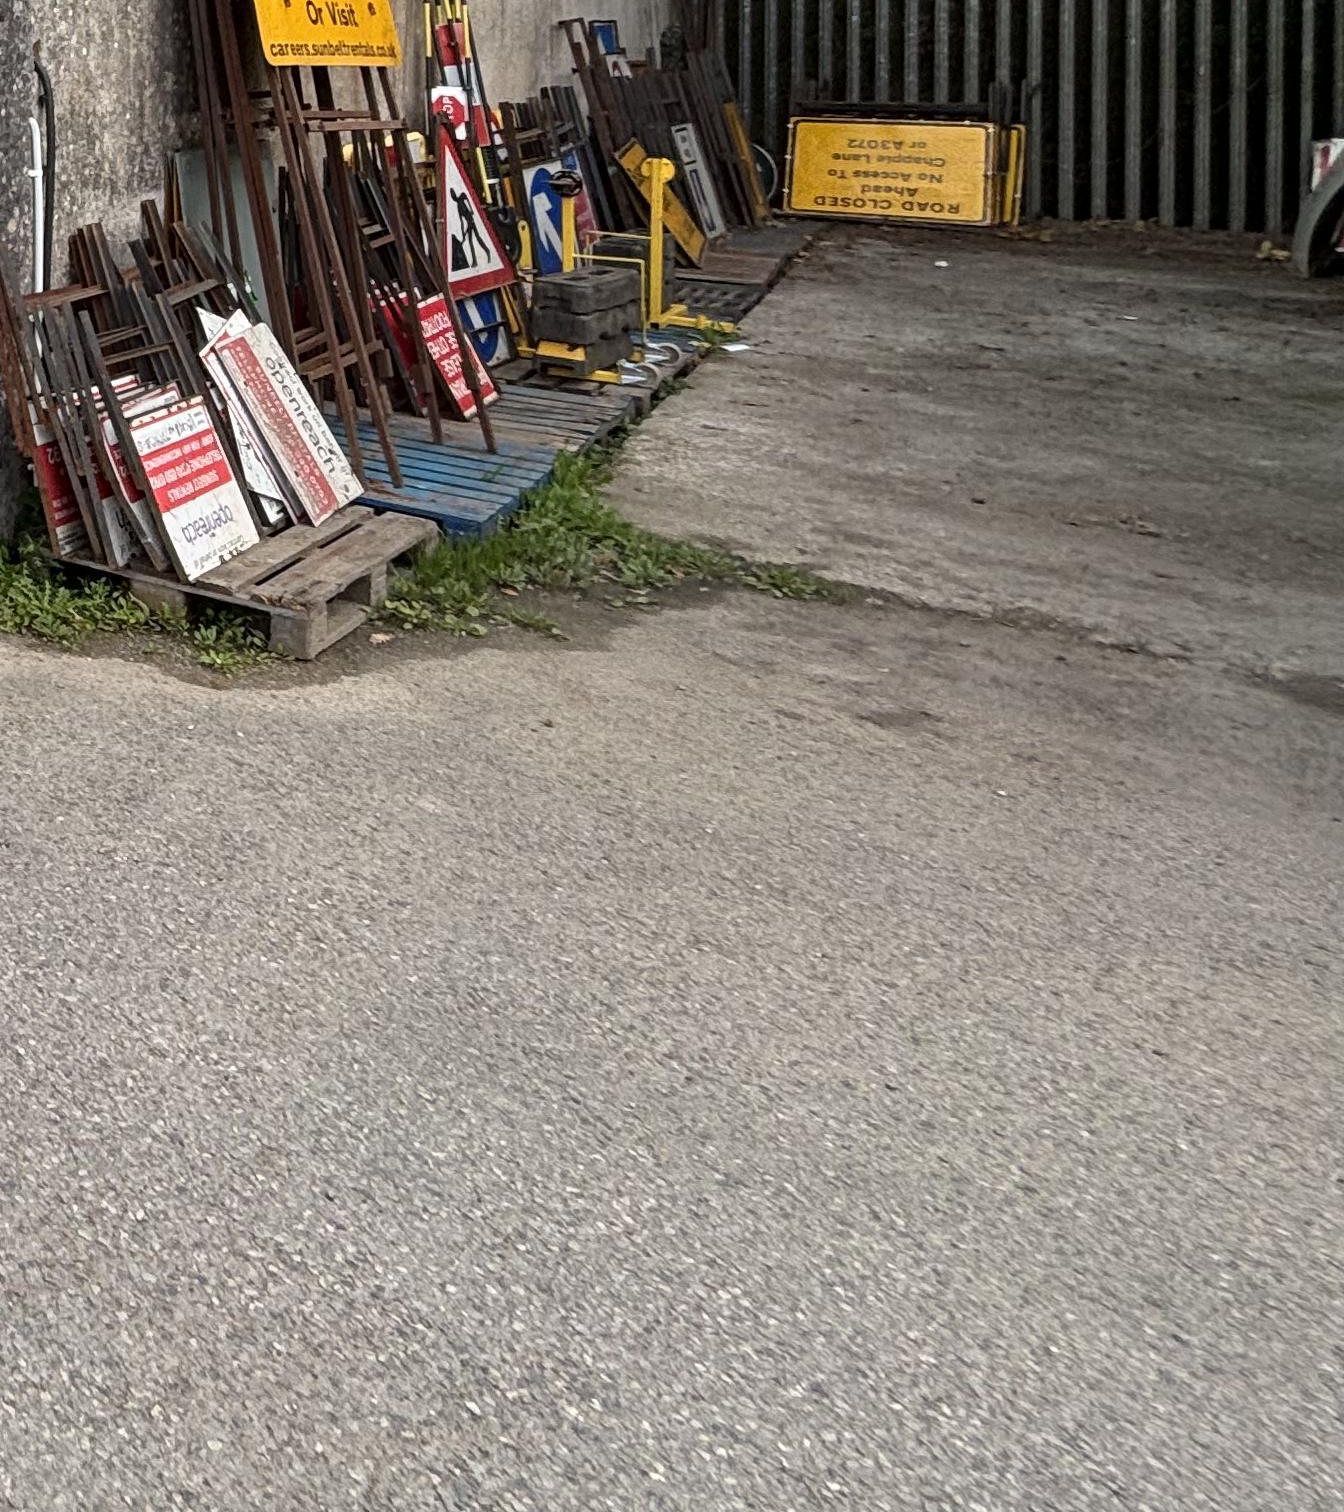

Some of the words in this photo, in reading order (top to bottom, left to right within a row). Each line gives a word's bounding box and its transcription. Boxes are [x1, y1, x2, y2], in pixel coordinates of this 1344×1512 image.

[306, 0, 324, 26] Or
[325, 1, 359, 28] Visit
[269, 39, 397, 59] careers.sunbeltrentals.co.uk
[847, 138, 905, 150] A3072
[908, 141, 927, 149] or
[831, 152, 870, 164] Lane
[827, 168, 847, 179] To
[853, 169, 912, 182] Access
[918, 173, 944, 184] No
[860, 184, 919, 197] Ahead
[813, 195, 892, 210] CLOSED
[901, 200, 961, 215] ROAD
[265, 356, 336, 473] openreach
[181, 504, 234, 544] openreach
